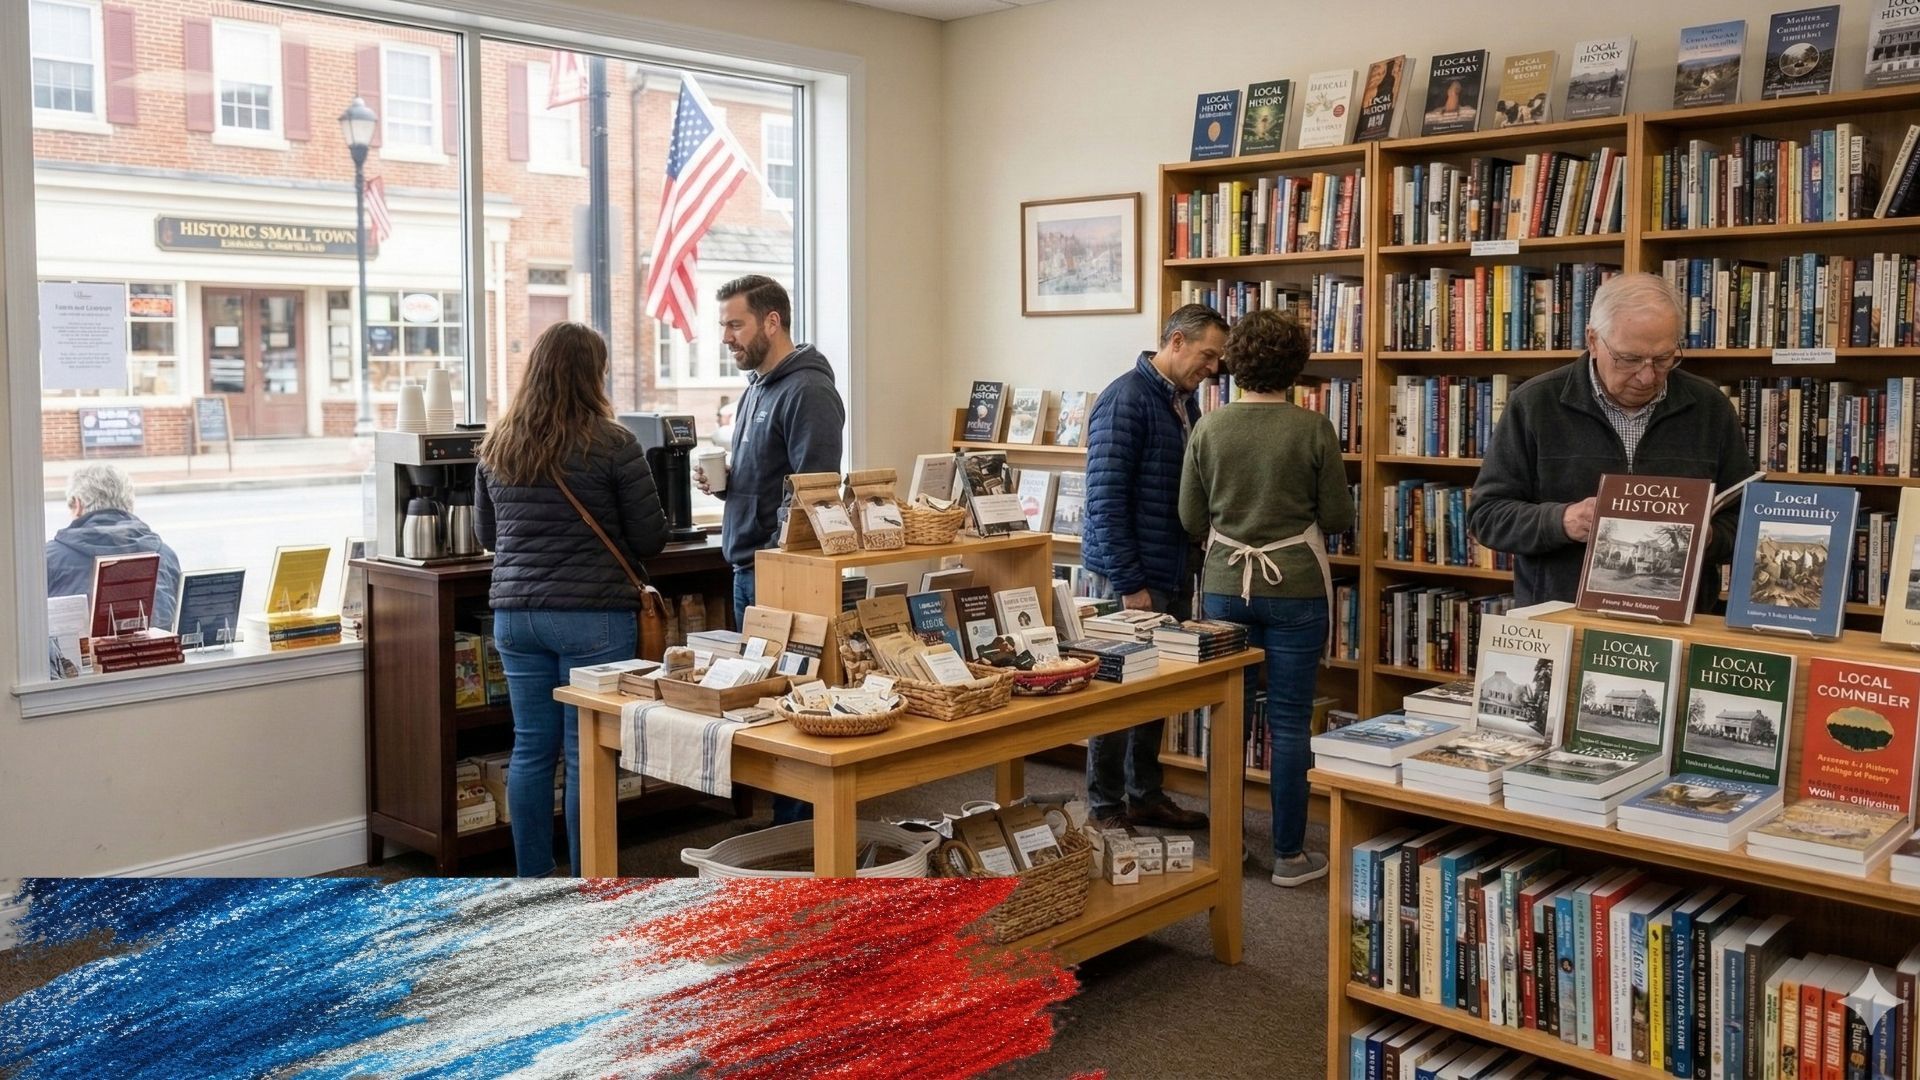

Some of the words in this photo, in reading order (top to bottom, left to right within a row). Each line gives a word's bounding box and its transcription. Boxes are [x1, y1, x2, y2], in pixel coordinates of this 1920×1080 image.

[1881, 5, 1920, 20] HISTO
[1586, 42, 1617, 54] LOCAL
[1579, 50, 1623, 64] HISTORY
[1433, 64, 1479, 77] HISTORY
[1206, 95, 1230, 104] LOCAL
[1254, 86, 1282, 97] LOCAL
[180, 221, 257, 239] HISTORIC
[259, 225, 311, 242] SMALL
[313, 229, 357, 244] TOWN
[976, 383, 998, 392] LOCAL
[1624, 483, 1680, 499] LOCAL
[1774, 491, 1818, 506] Local
[1611, 498, 1690, 516] HISTORY
[1754, 504, 1840, 522] Community
[1501, 624, 1544, 640] LOCAL
[1492, 636, 1551, 655] HISTORY
[1602, 640, 1651, 658] LOCAL
[1592, 654, 1659, 673] HISTORY
[1712, 655, 1767, 675] LOCAL
[1701, 670, 1776, 692] HISTORY
[1838, 671, 1893, 690] LOCAL
[1817, 685, 1911, 709] COMNBLER
